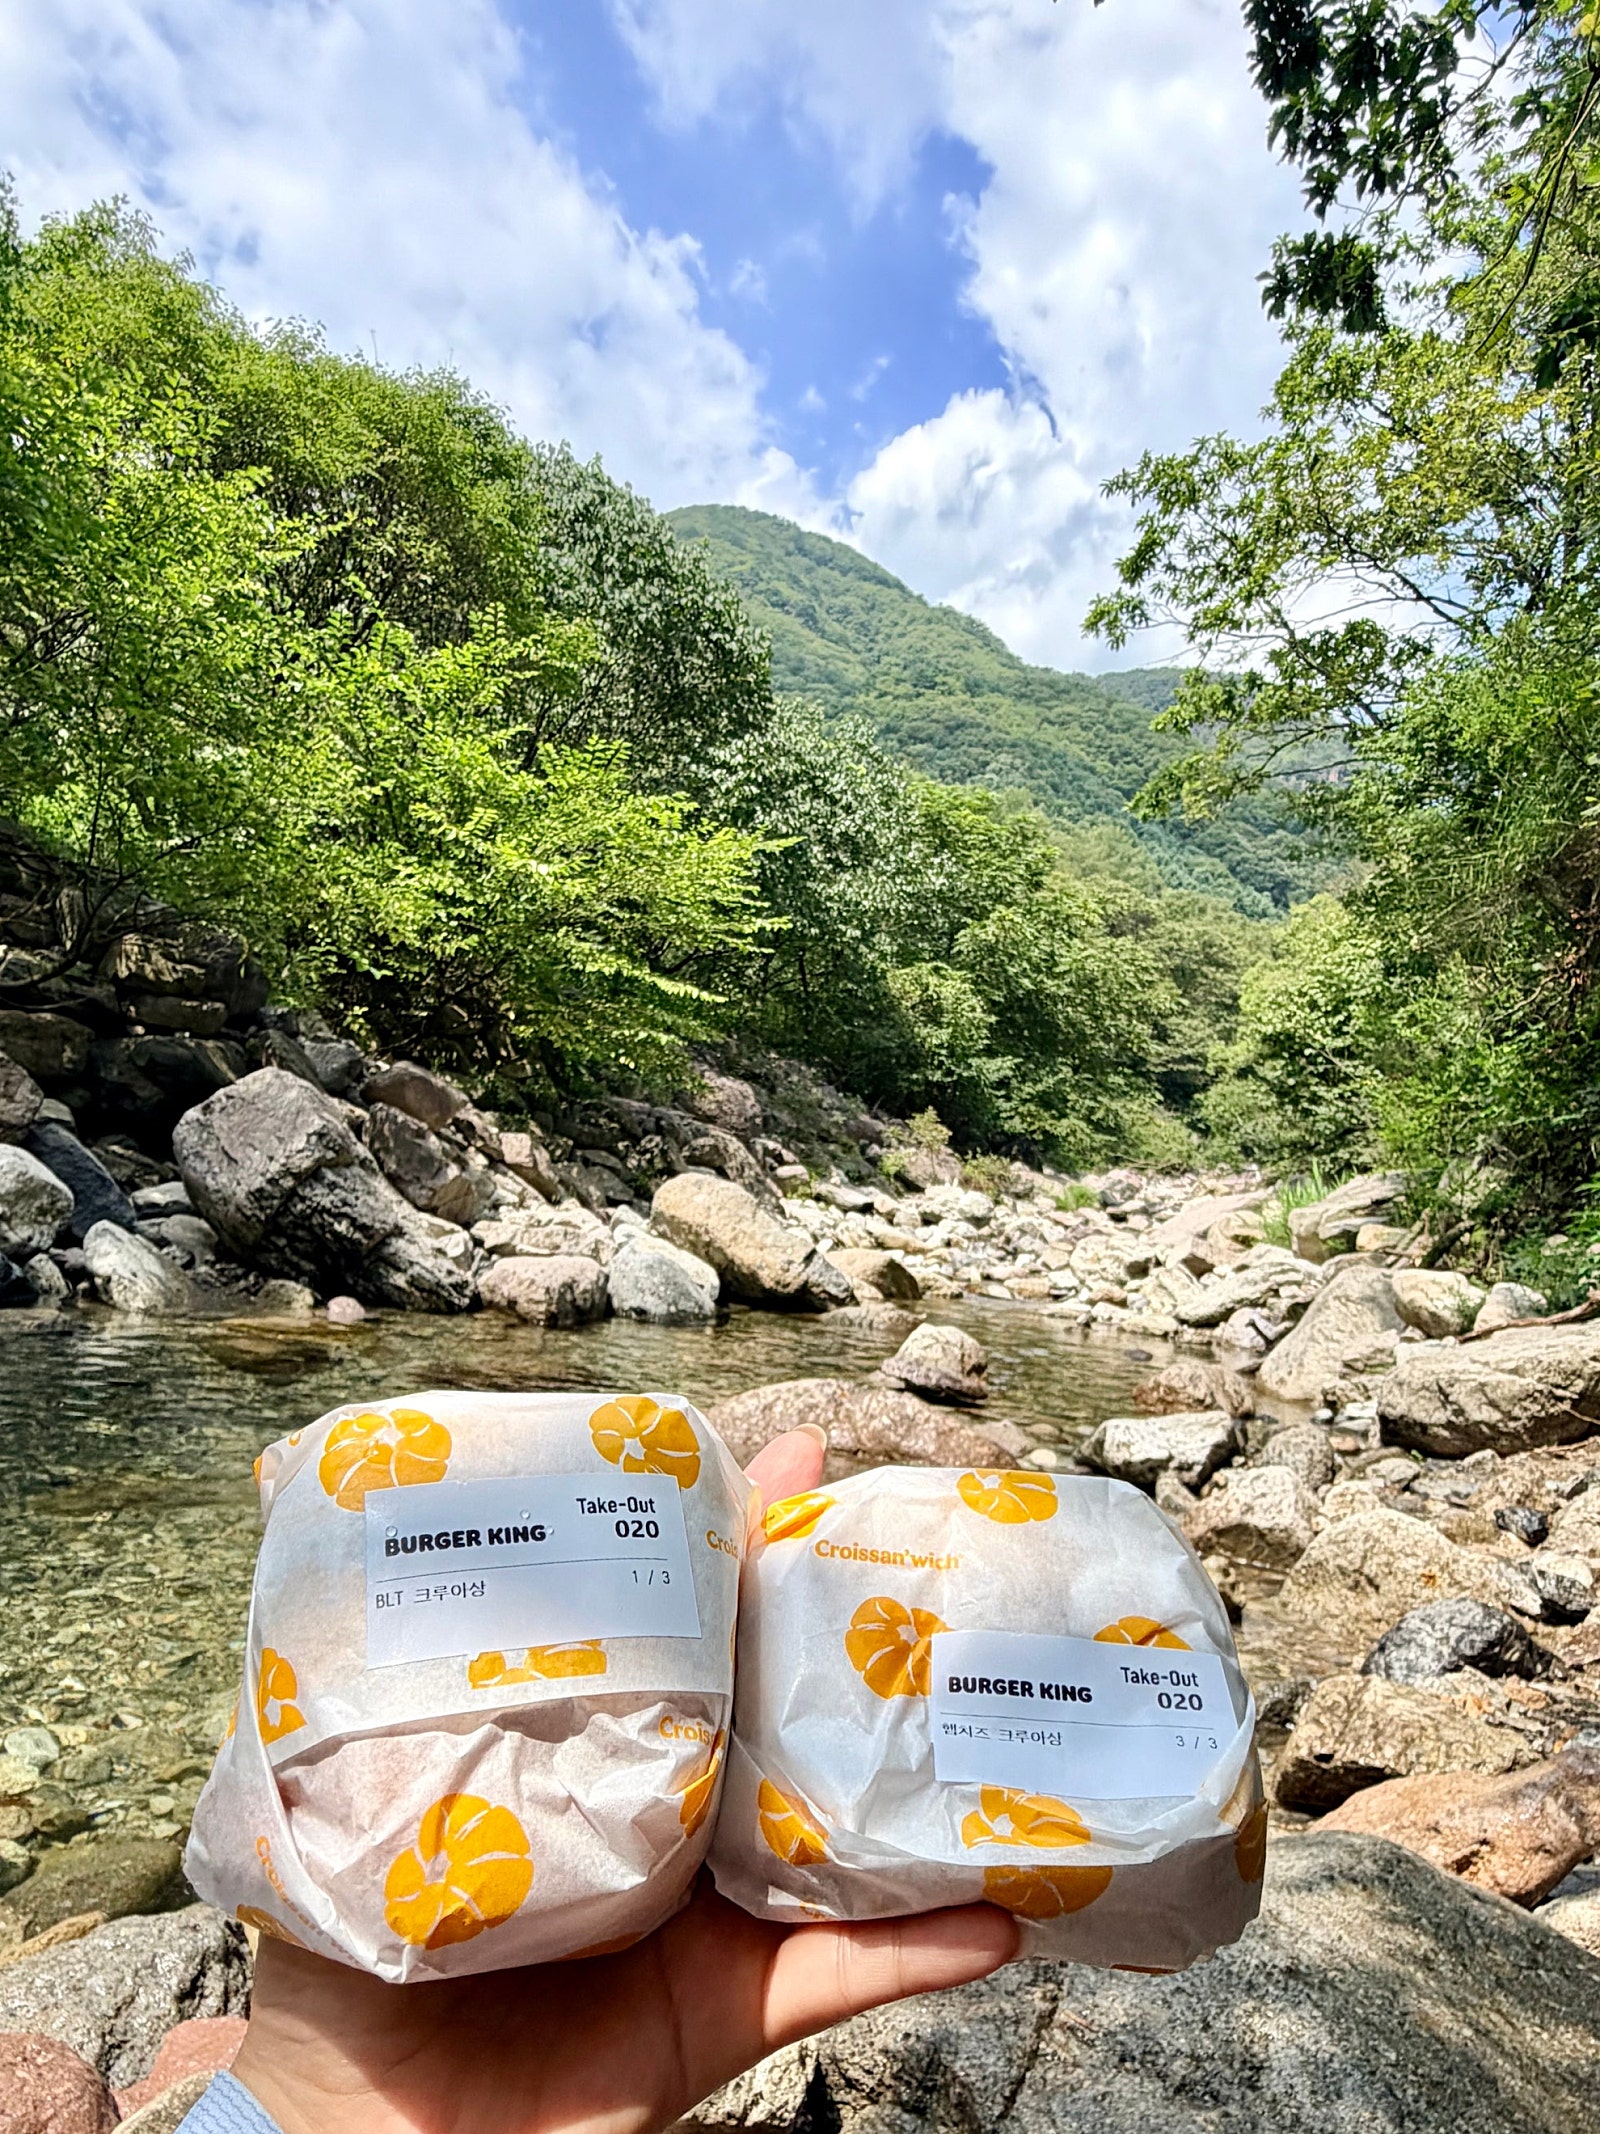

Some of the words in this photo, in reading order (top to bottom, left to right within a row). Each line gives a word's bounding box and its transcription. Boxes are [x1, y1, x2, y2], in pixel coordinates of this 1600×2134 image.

[576, 1497, 656, 1515] Take-Out
[615, 1520, 660, 1538] 020
[385, 1529, 482, 1557] BURGER
[488, 1524, 547, 1545] KING
[632, 1570, 638, 1584] 1
[662, 1570, 671, 1584] 3
[376, 1591, 403, 1609] BLT
[1120, 1667, 1199, 1687] Take-Out
[948, 1676, 1034, 1699] BURGER
[1040, 1683, 1093, 1703] KING
[1157, 1692, 1203, 1711] 020
[659, 1715, 714, 1746] Crois
[1176, 1735, 1185, 1748] 3
[1208, 1737, 1218, 1750] 3
